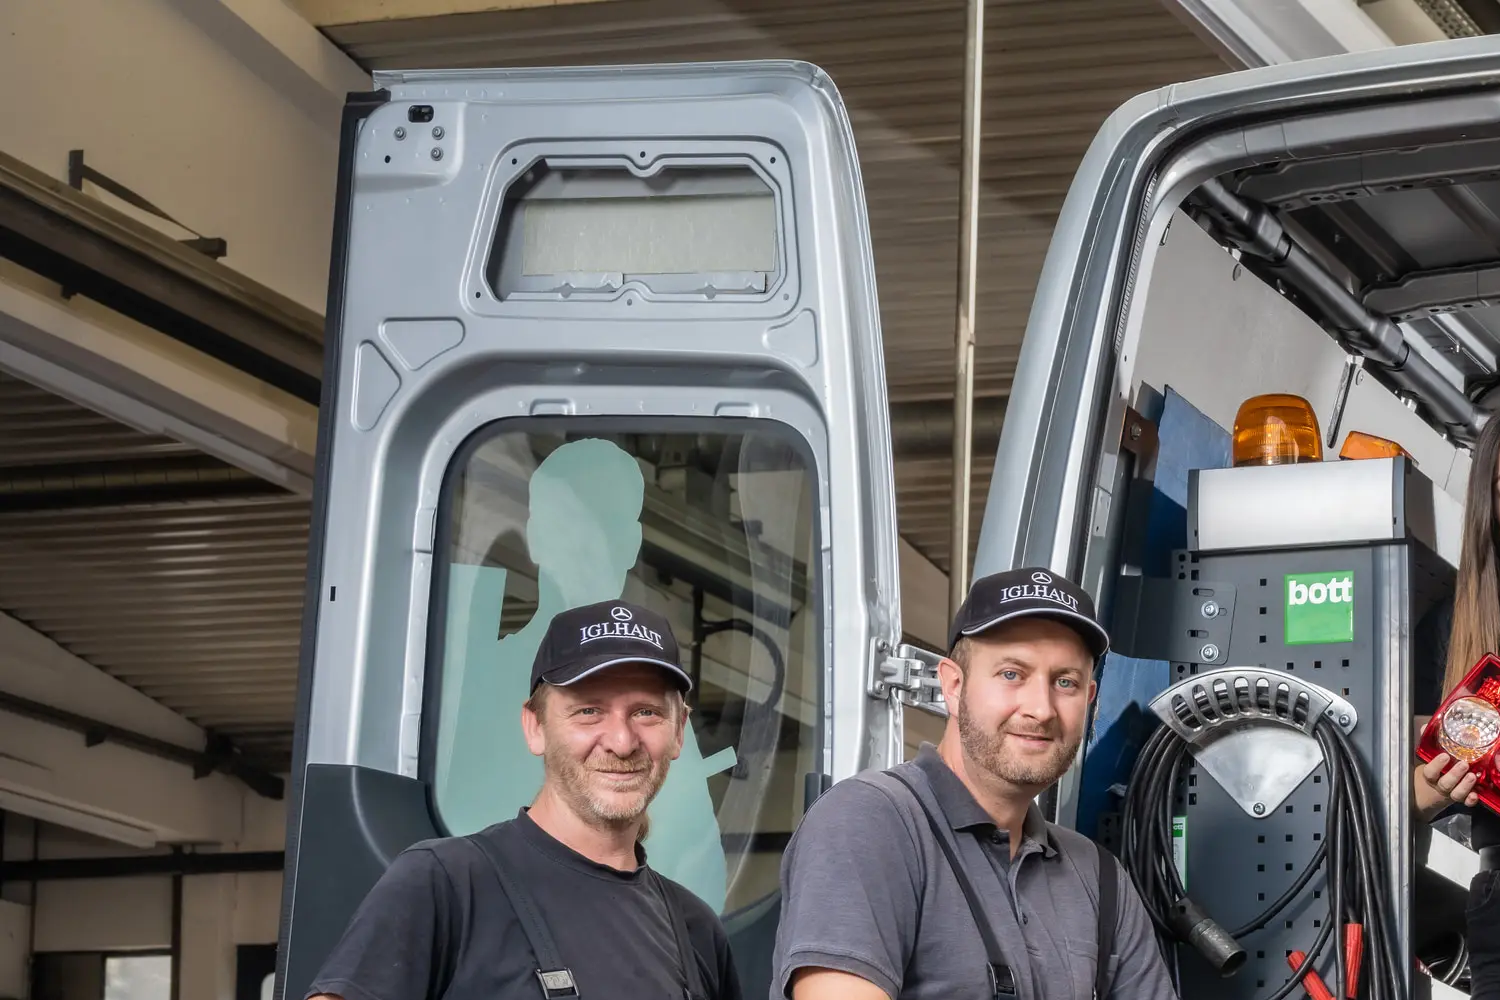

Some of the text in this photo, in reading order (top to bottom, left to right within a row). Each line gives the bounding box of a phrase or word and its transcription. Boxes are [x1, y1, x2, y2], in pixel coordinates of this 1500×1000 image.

[1000, 584, 1079, 611] IGLHAUT
[1288, 577, 1353, 606] bott
[579, 621, 662, 646] IGLHAUT
